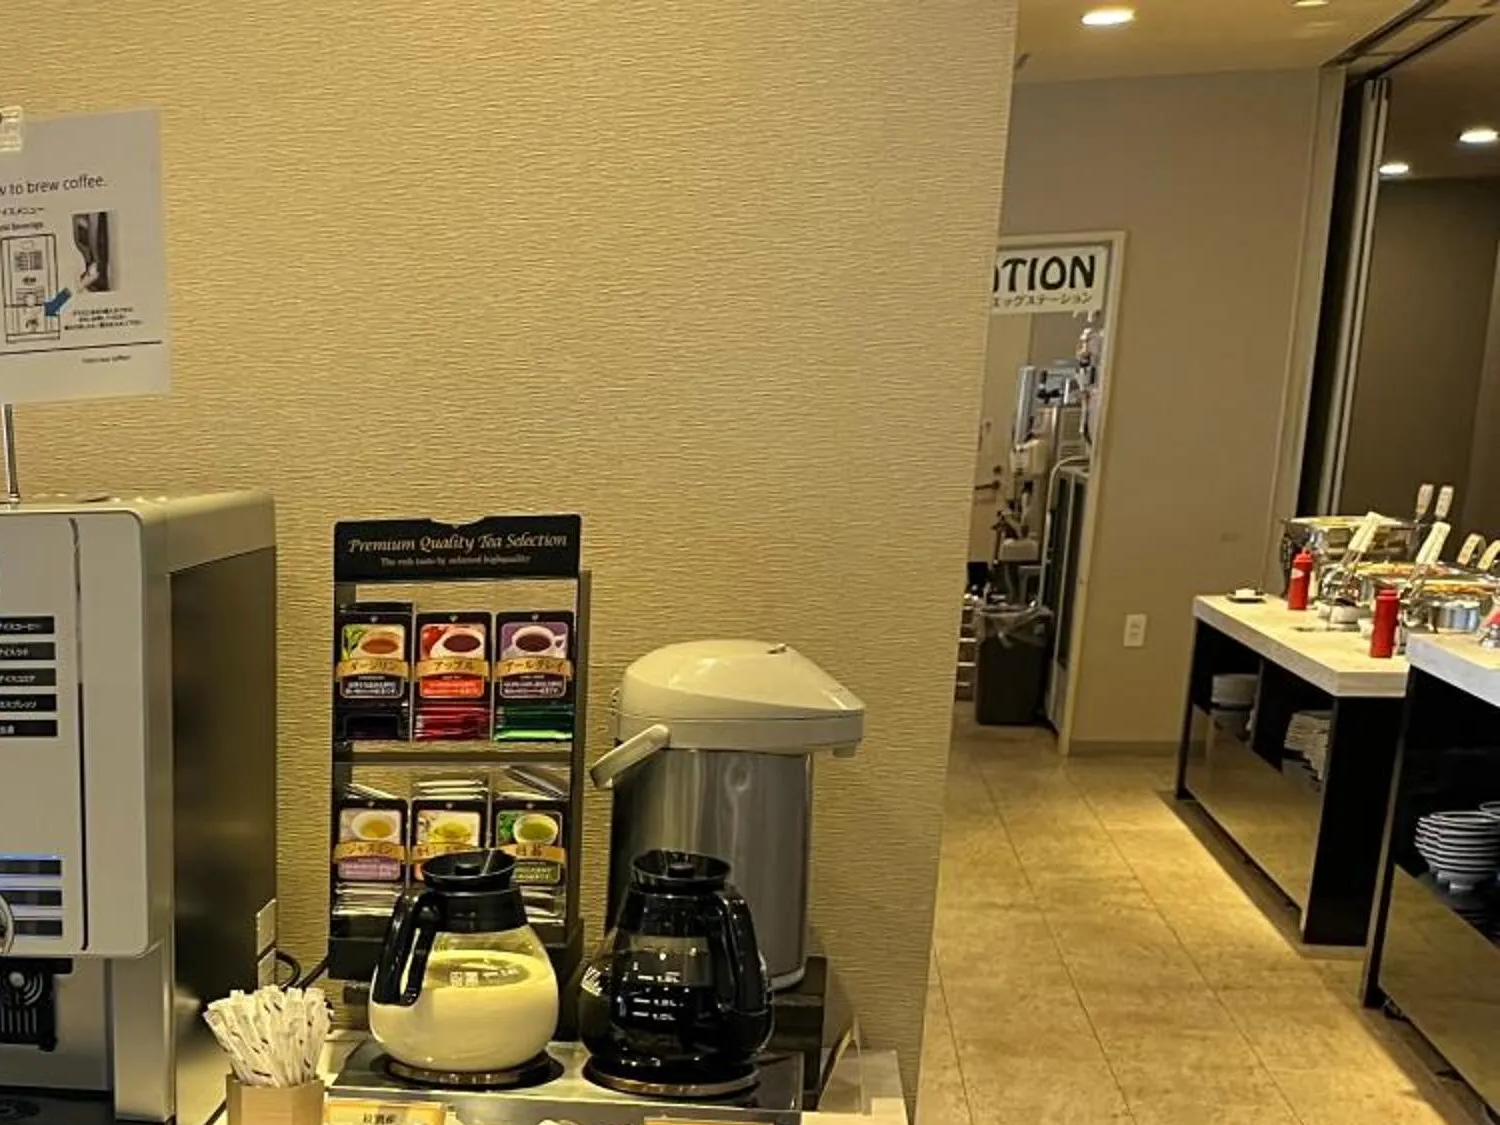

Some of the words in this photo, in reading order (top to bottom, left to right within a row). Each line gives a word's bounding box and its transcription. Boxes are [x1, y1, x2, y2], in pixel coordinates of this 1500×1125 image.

[10, 183, 25, 195] to
[28, 180, 60, 194] brew
[63, 175, 109, 189] coffee.
[347, 538, 416, 553] Premium
[419, 533, 475, 555] Quality
[477, 533, 503, 549] Tea
[506, 531, 567, 548] Selection
